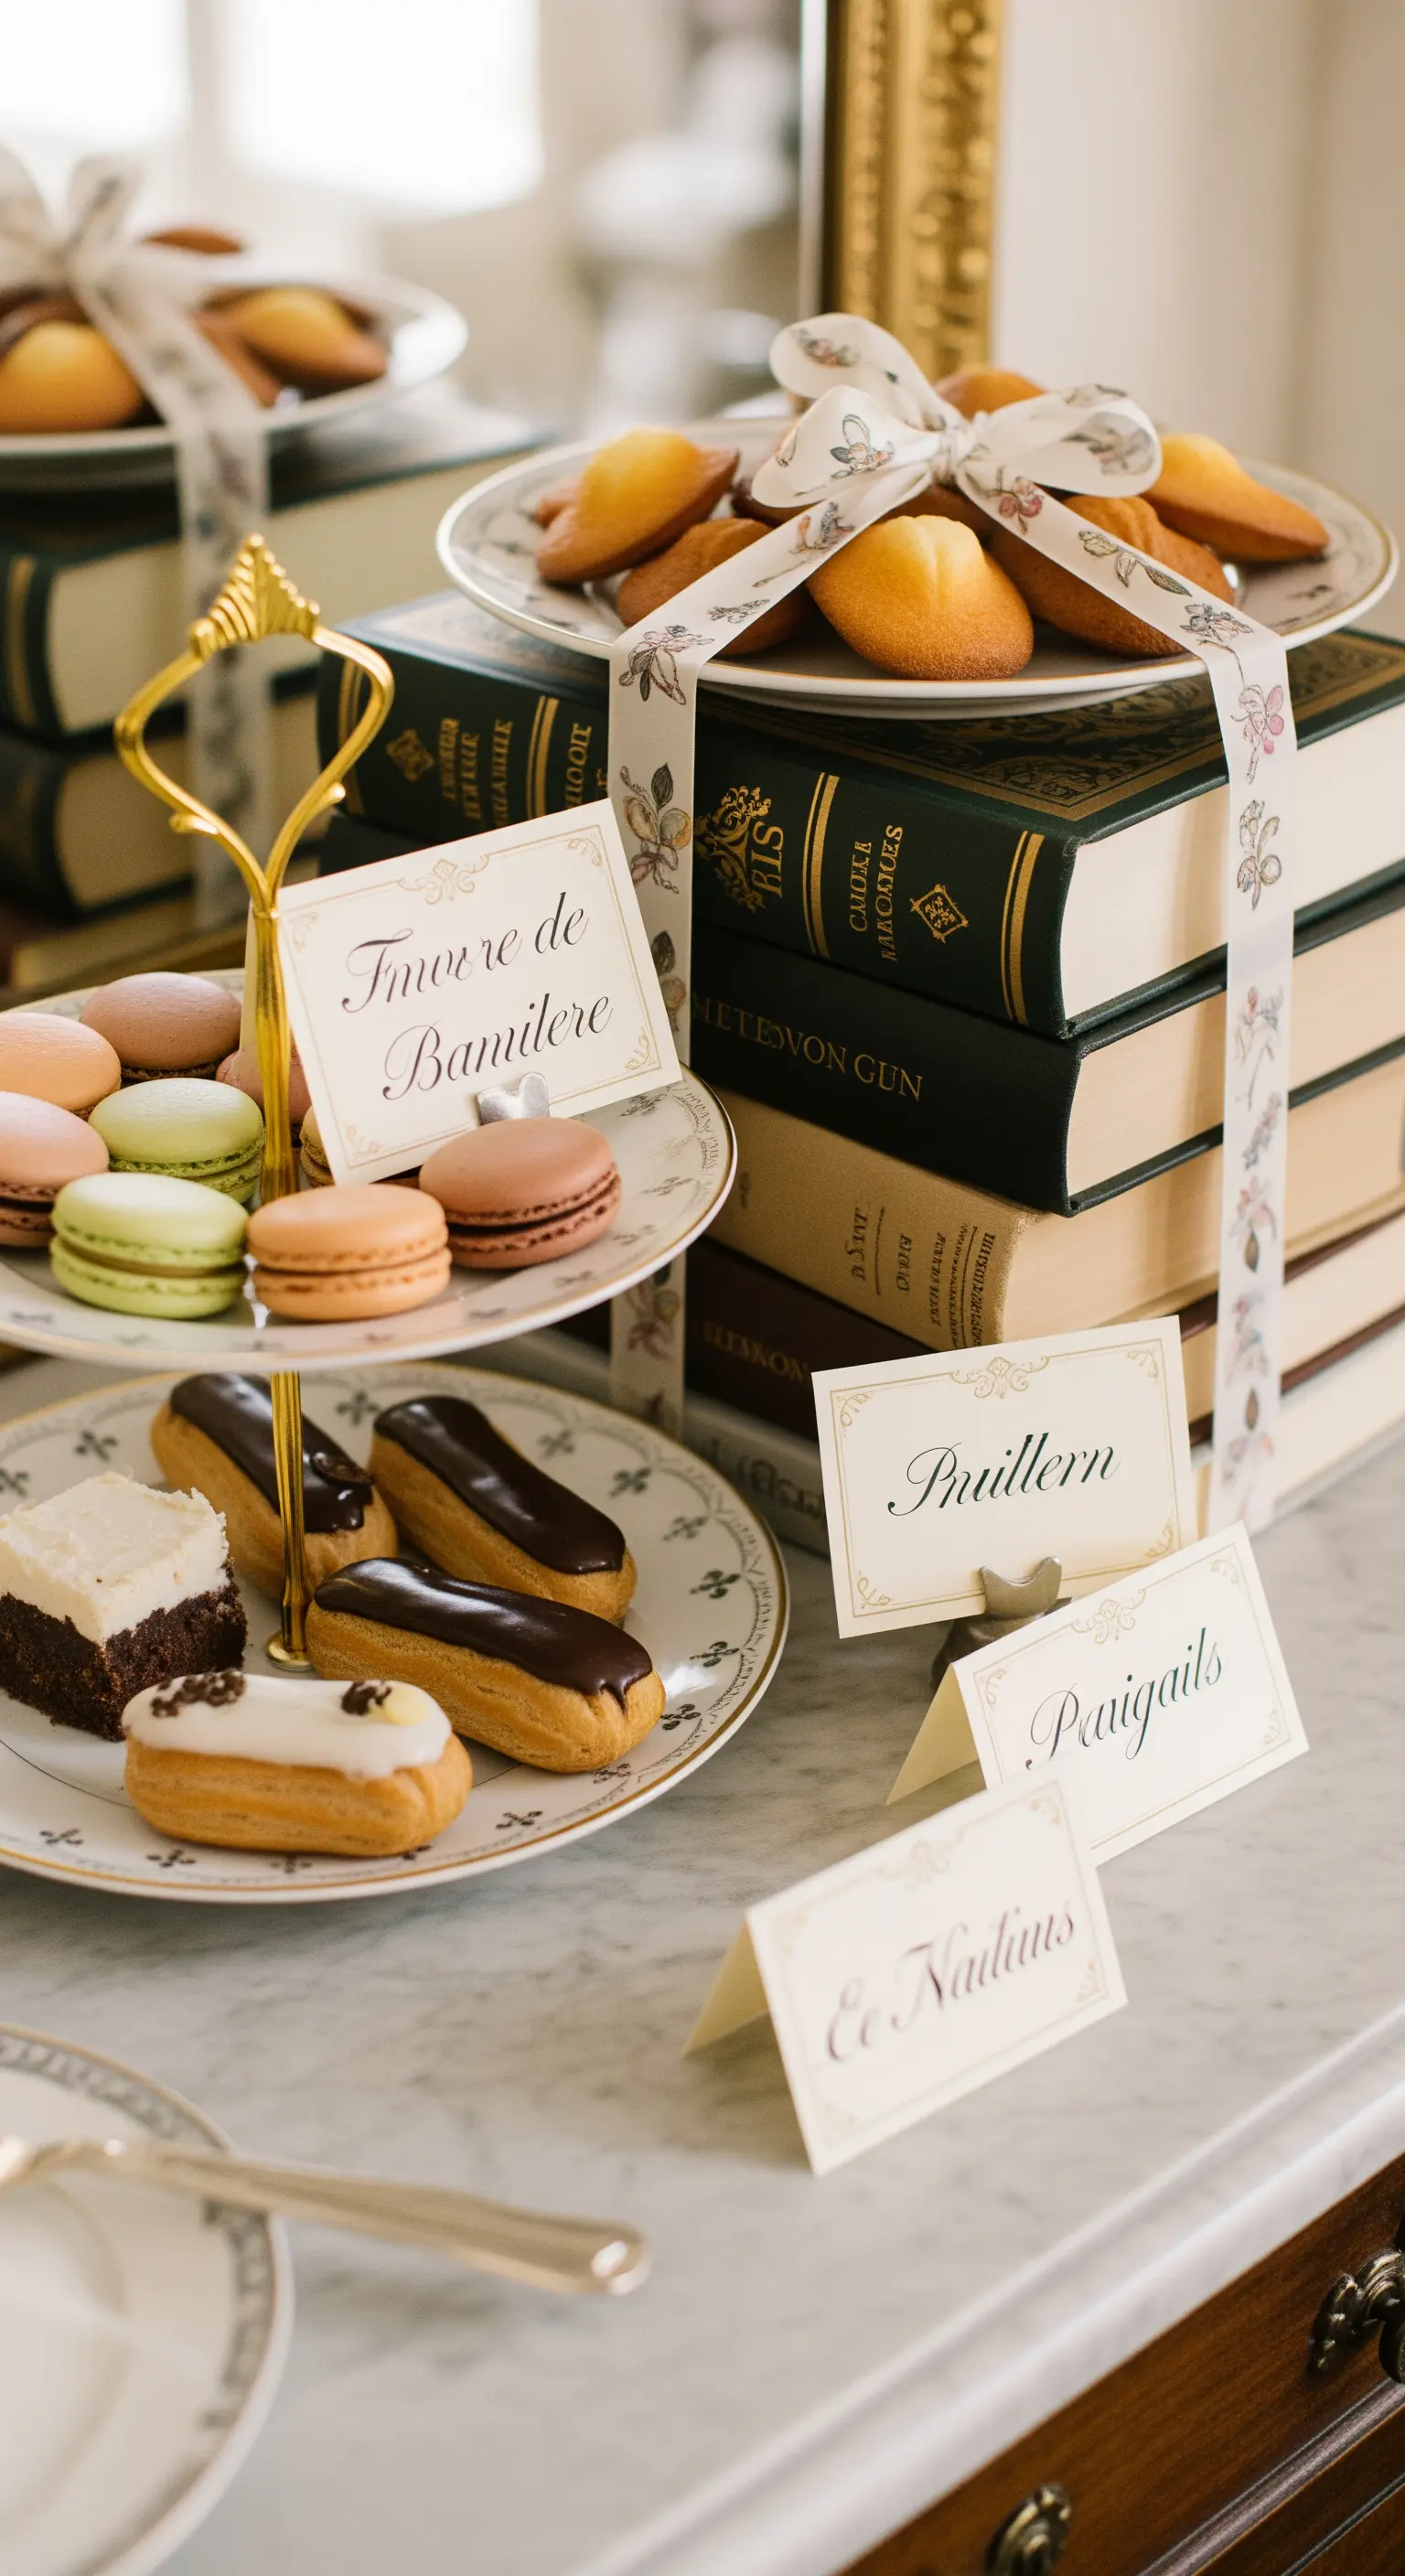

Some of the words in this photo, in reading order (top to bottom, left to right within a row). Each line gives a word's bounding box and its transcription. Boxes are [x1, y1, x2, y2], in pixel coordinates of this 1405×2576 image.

[534, 892, 589, 953] de
[382, 993, 614, 1100] Bamilere
[853, 1055, 922, 1101] GUN
